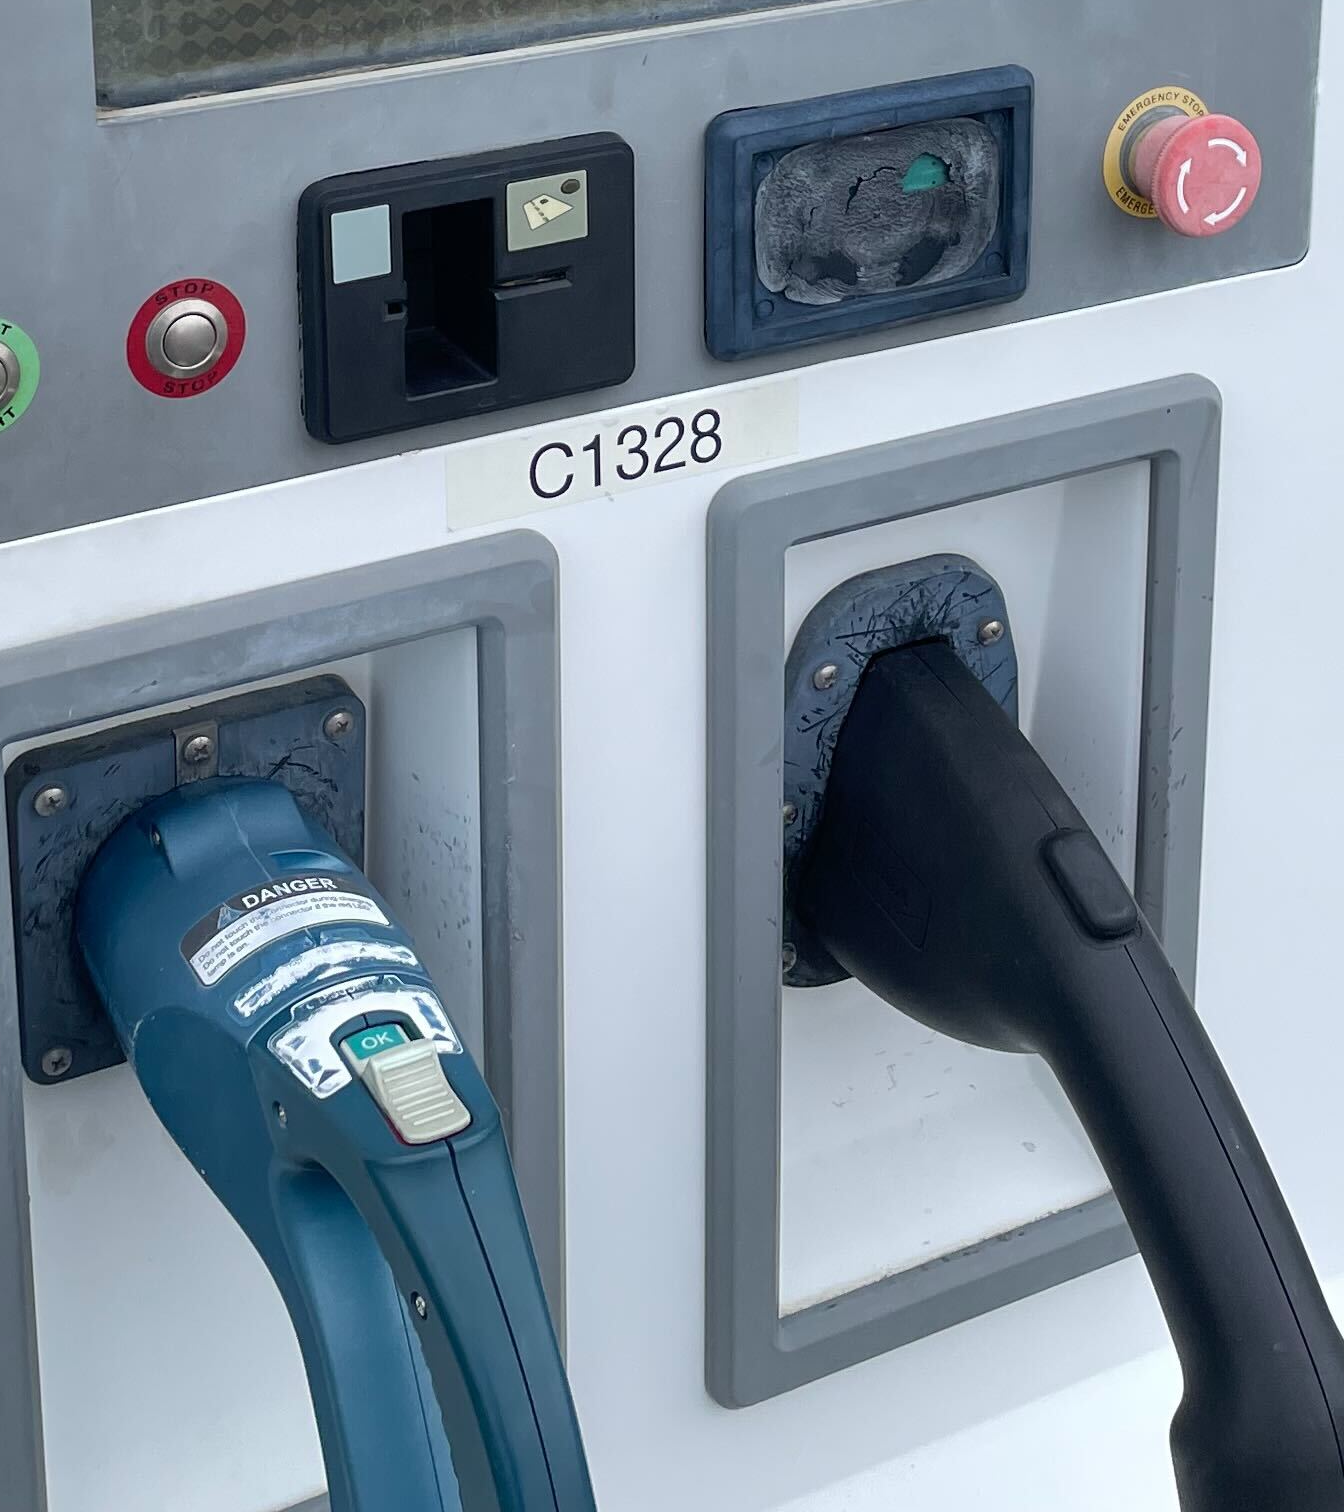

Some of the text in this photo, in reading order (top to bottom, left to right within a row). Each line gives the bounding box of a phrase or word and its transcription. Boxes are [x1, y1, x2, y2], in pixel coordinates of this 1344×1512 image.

[1117, 91, 1204, 131] EMERGENCY STOP
[1115, 186, 1158, 215] EMERGE
[155, 282, 214, 306] STOP
[163, 370, 219, 394] STOP
[529, 408, 722, 499] C1328
[241, 877, 338, 909] DANGER
[361, 1031, 395, 1049] OK
